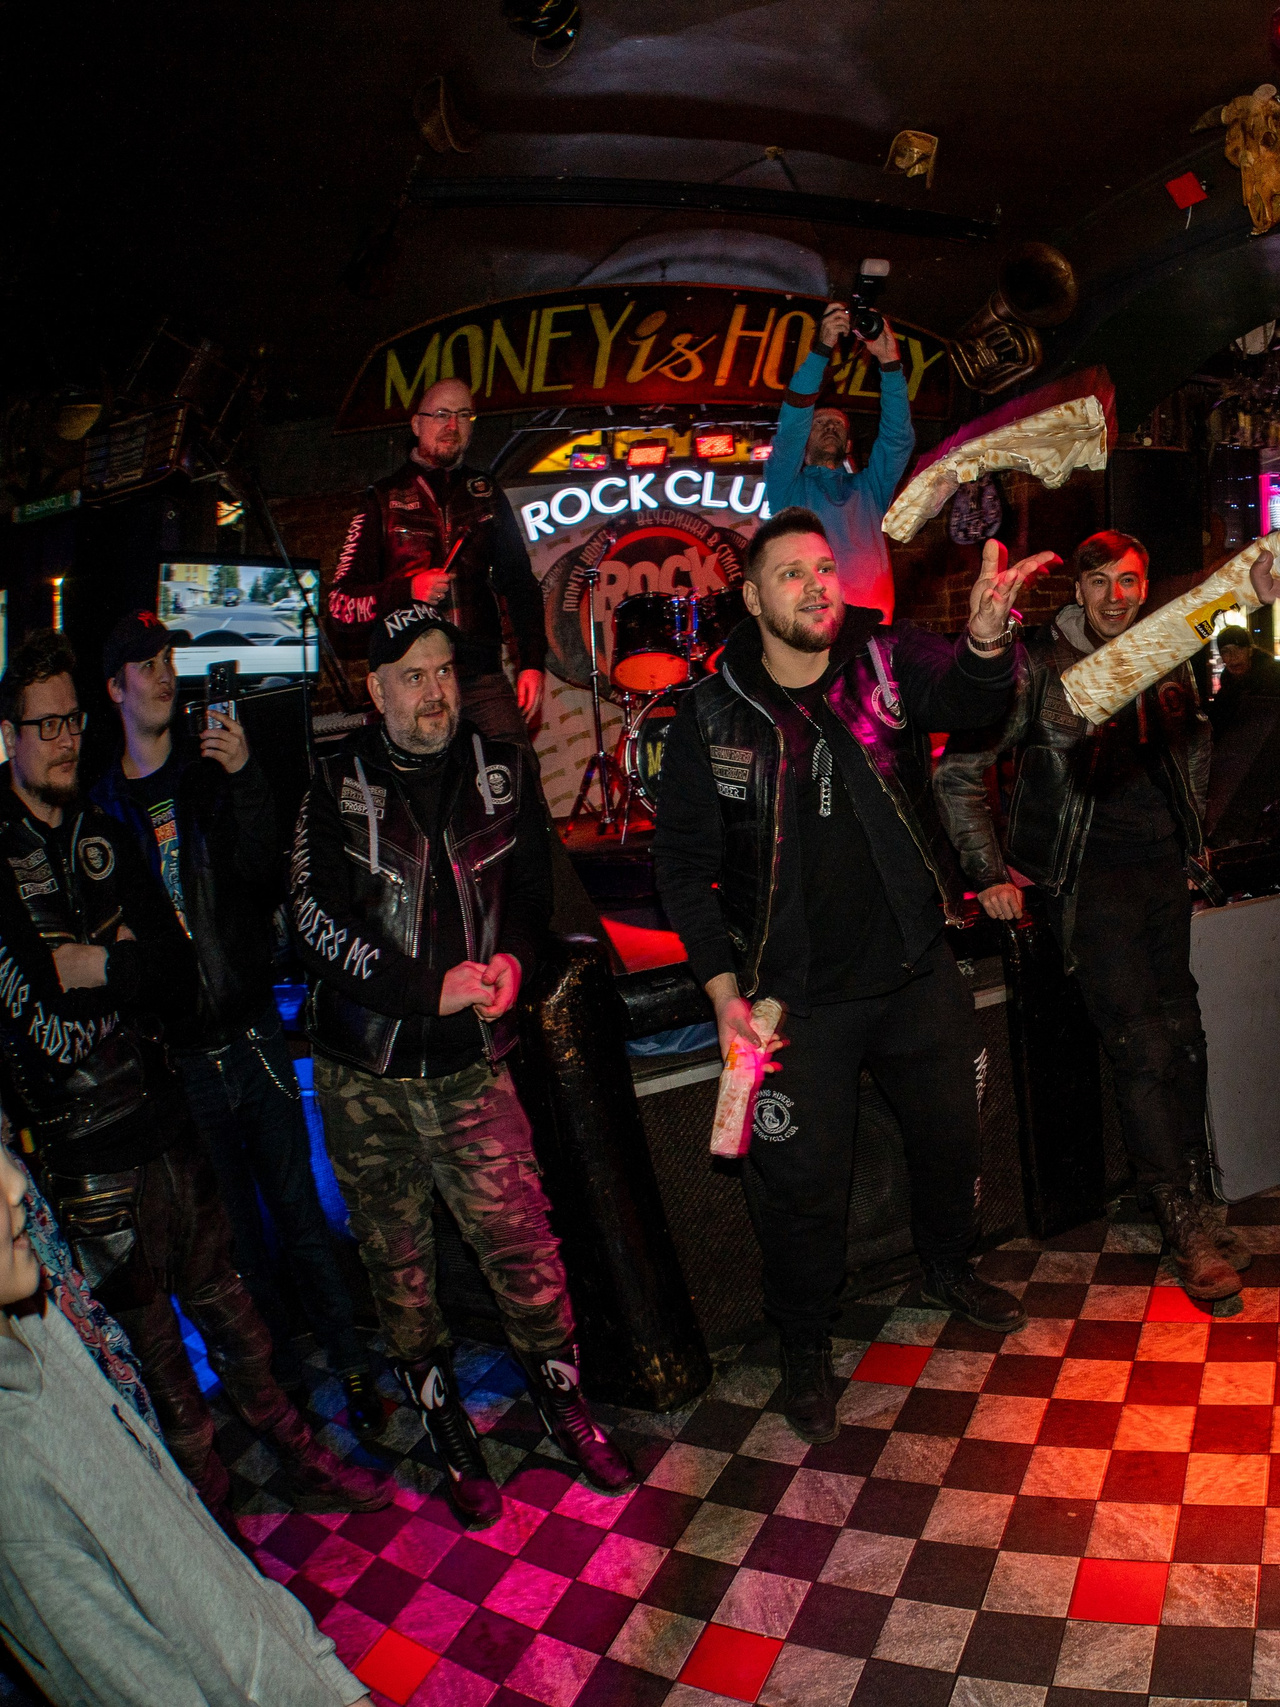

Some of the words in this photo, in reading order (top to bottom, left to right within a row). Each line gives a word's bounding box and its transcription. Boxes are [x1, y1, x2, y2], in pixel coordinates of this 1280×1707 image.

[384, 301, 637, 411] MONEY
[627, 309, 718, 384] is
[520, 472, 660, 542] ROCK
[663, 469, 773, 520] CLU
[594, 544, 730, 622] ROCK
[384, 603, 443, 639] NRMC
[343, 800, 380, 818] PROSPT
[342, 936, 380, 980] MC
